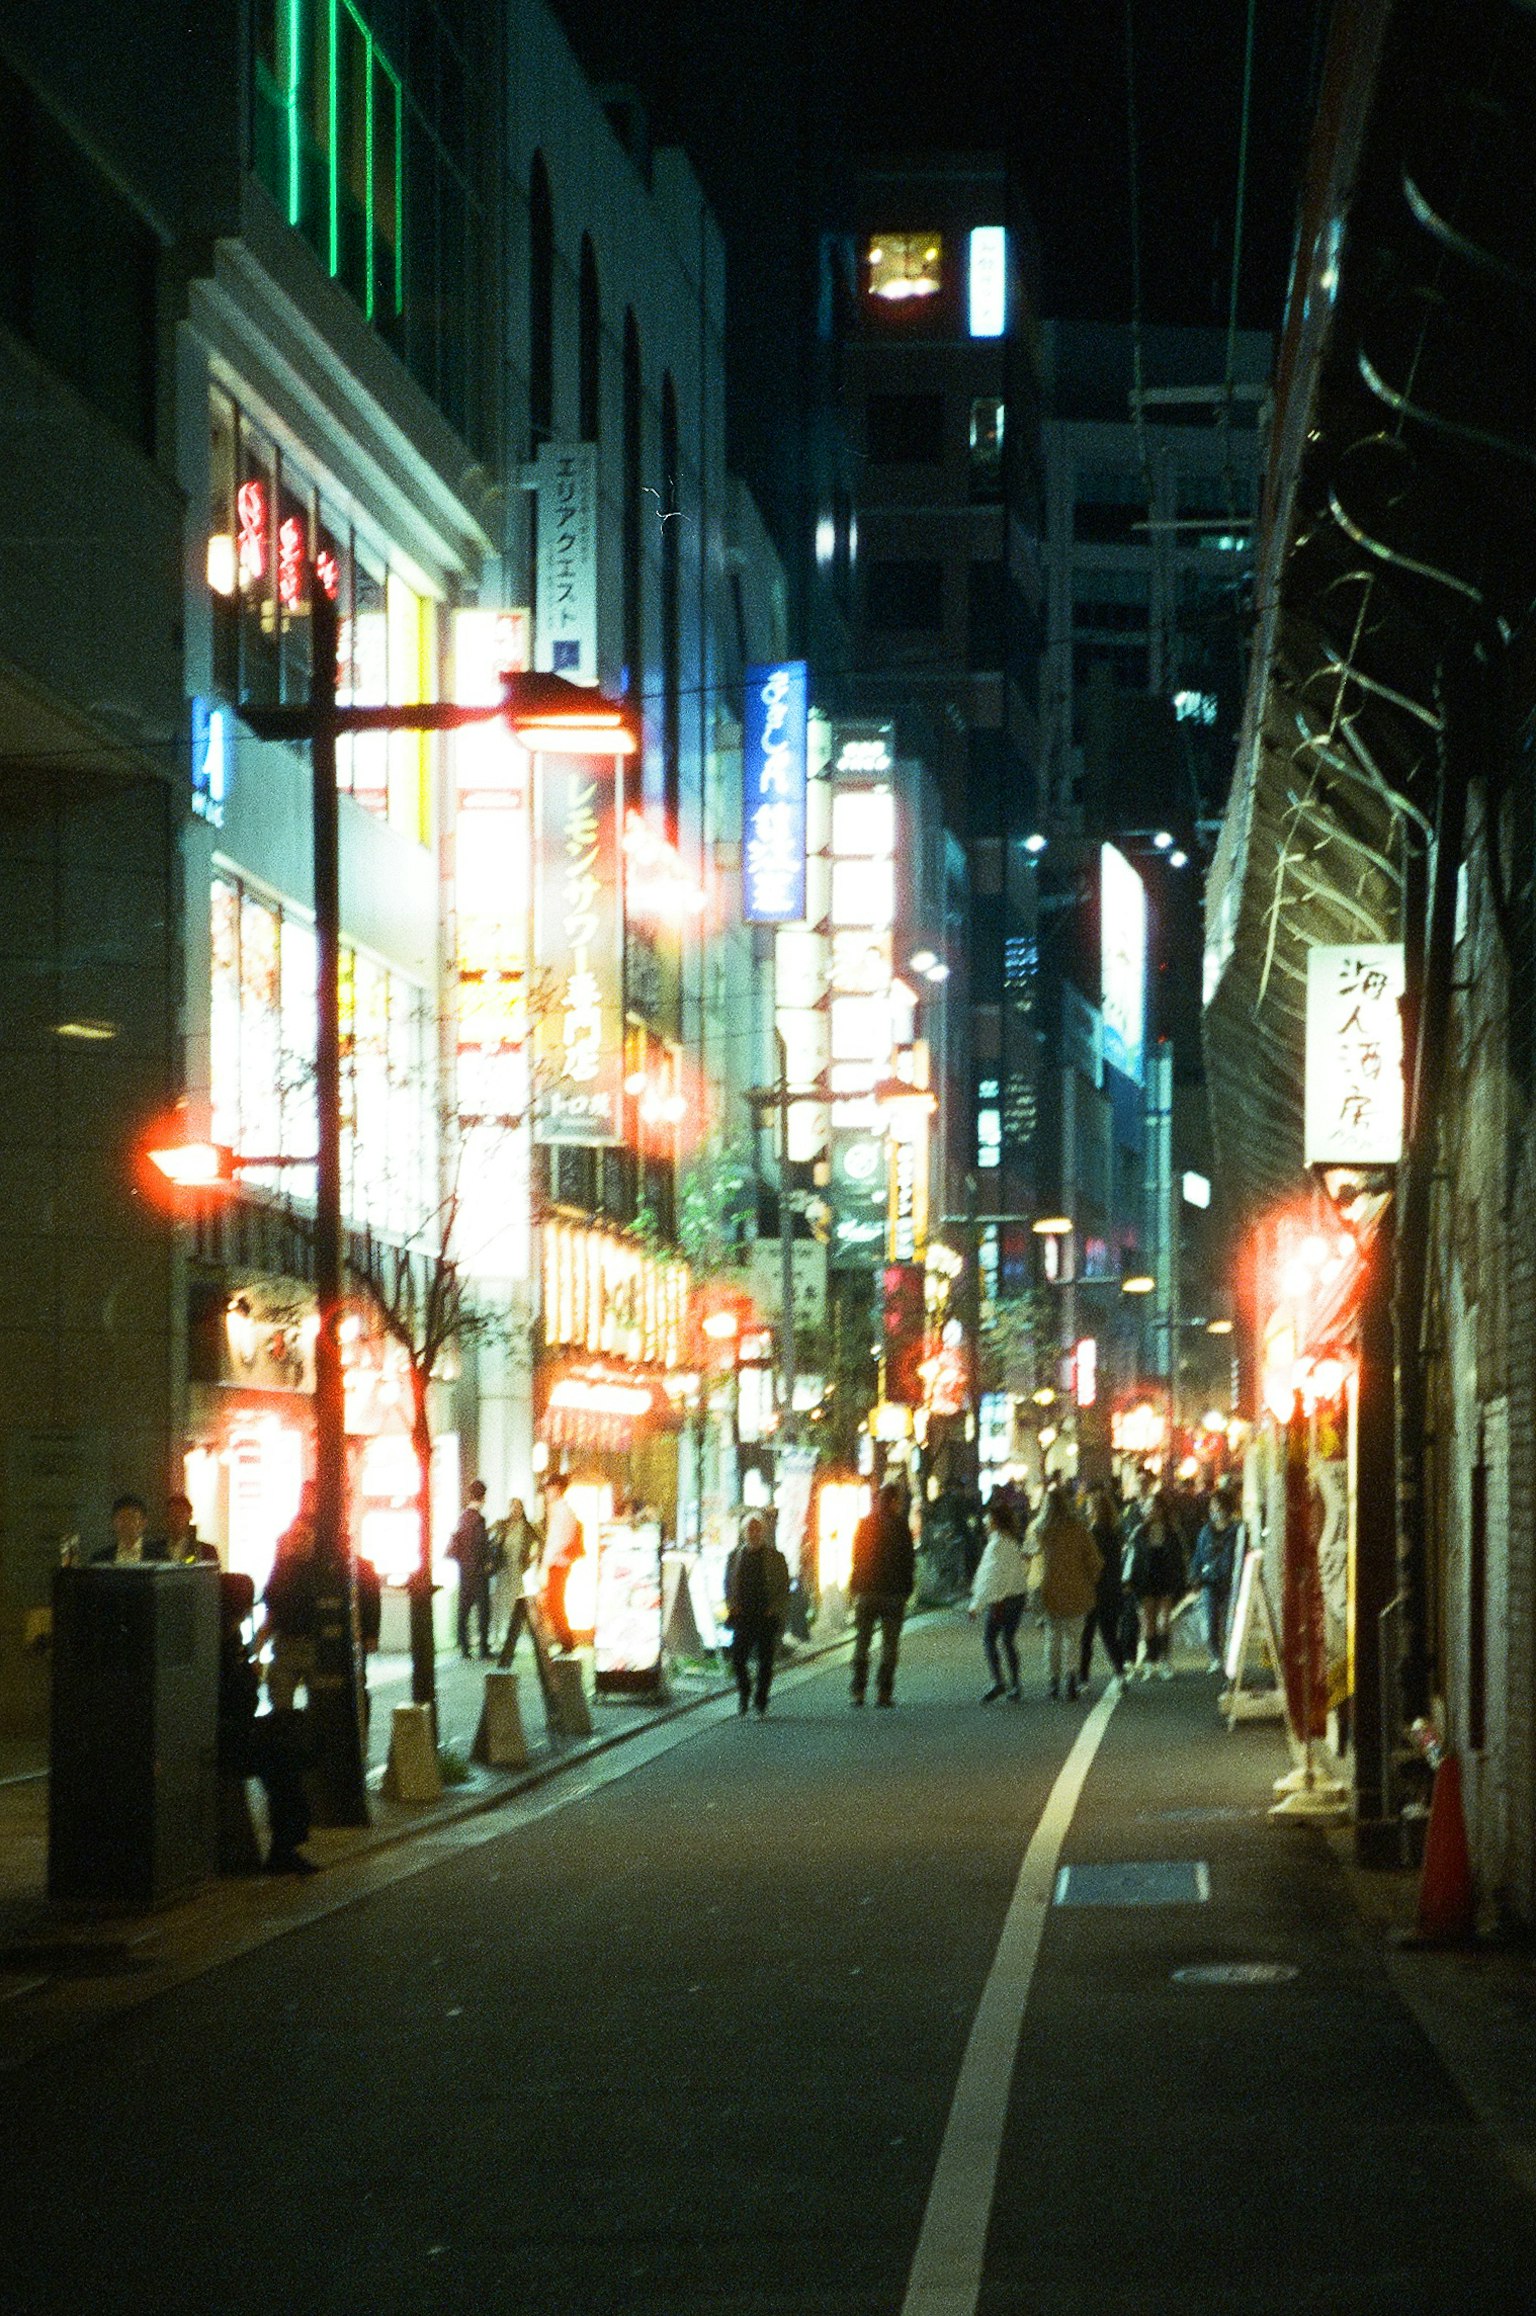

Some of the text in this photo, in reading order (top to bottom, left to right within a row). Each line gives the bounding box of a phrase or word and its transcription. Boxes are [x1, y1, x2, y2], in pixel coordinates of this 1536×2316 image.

[556, 457, 577, 630] エリアクエスト
